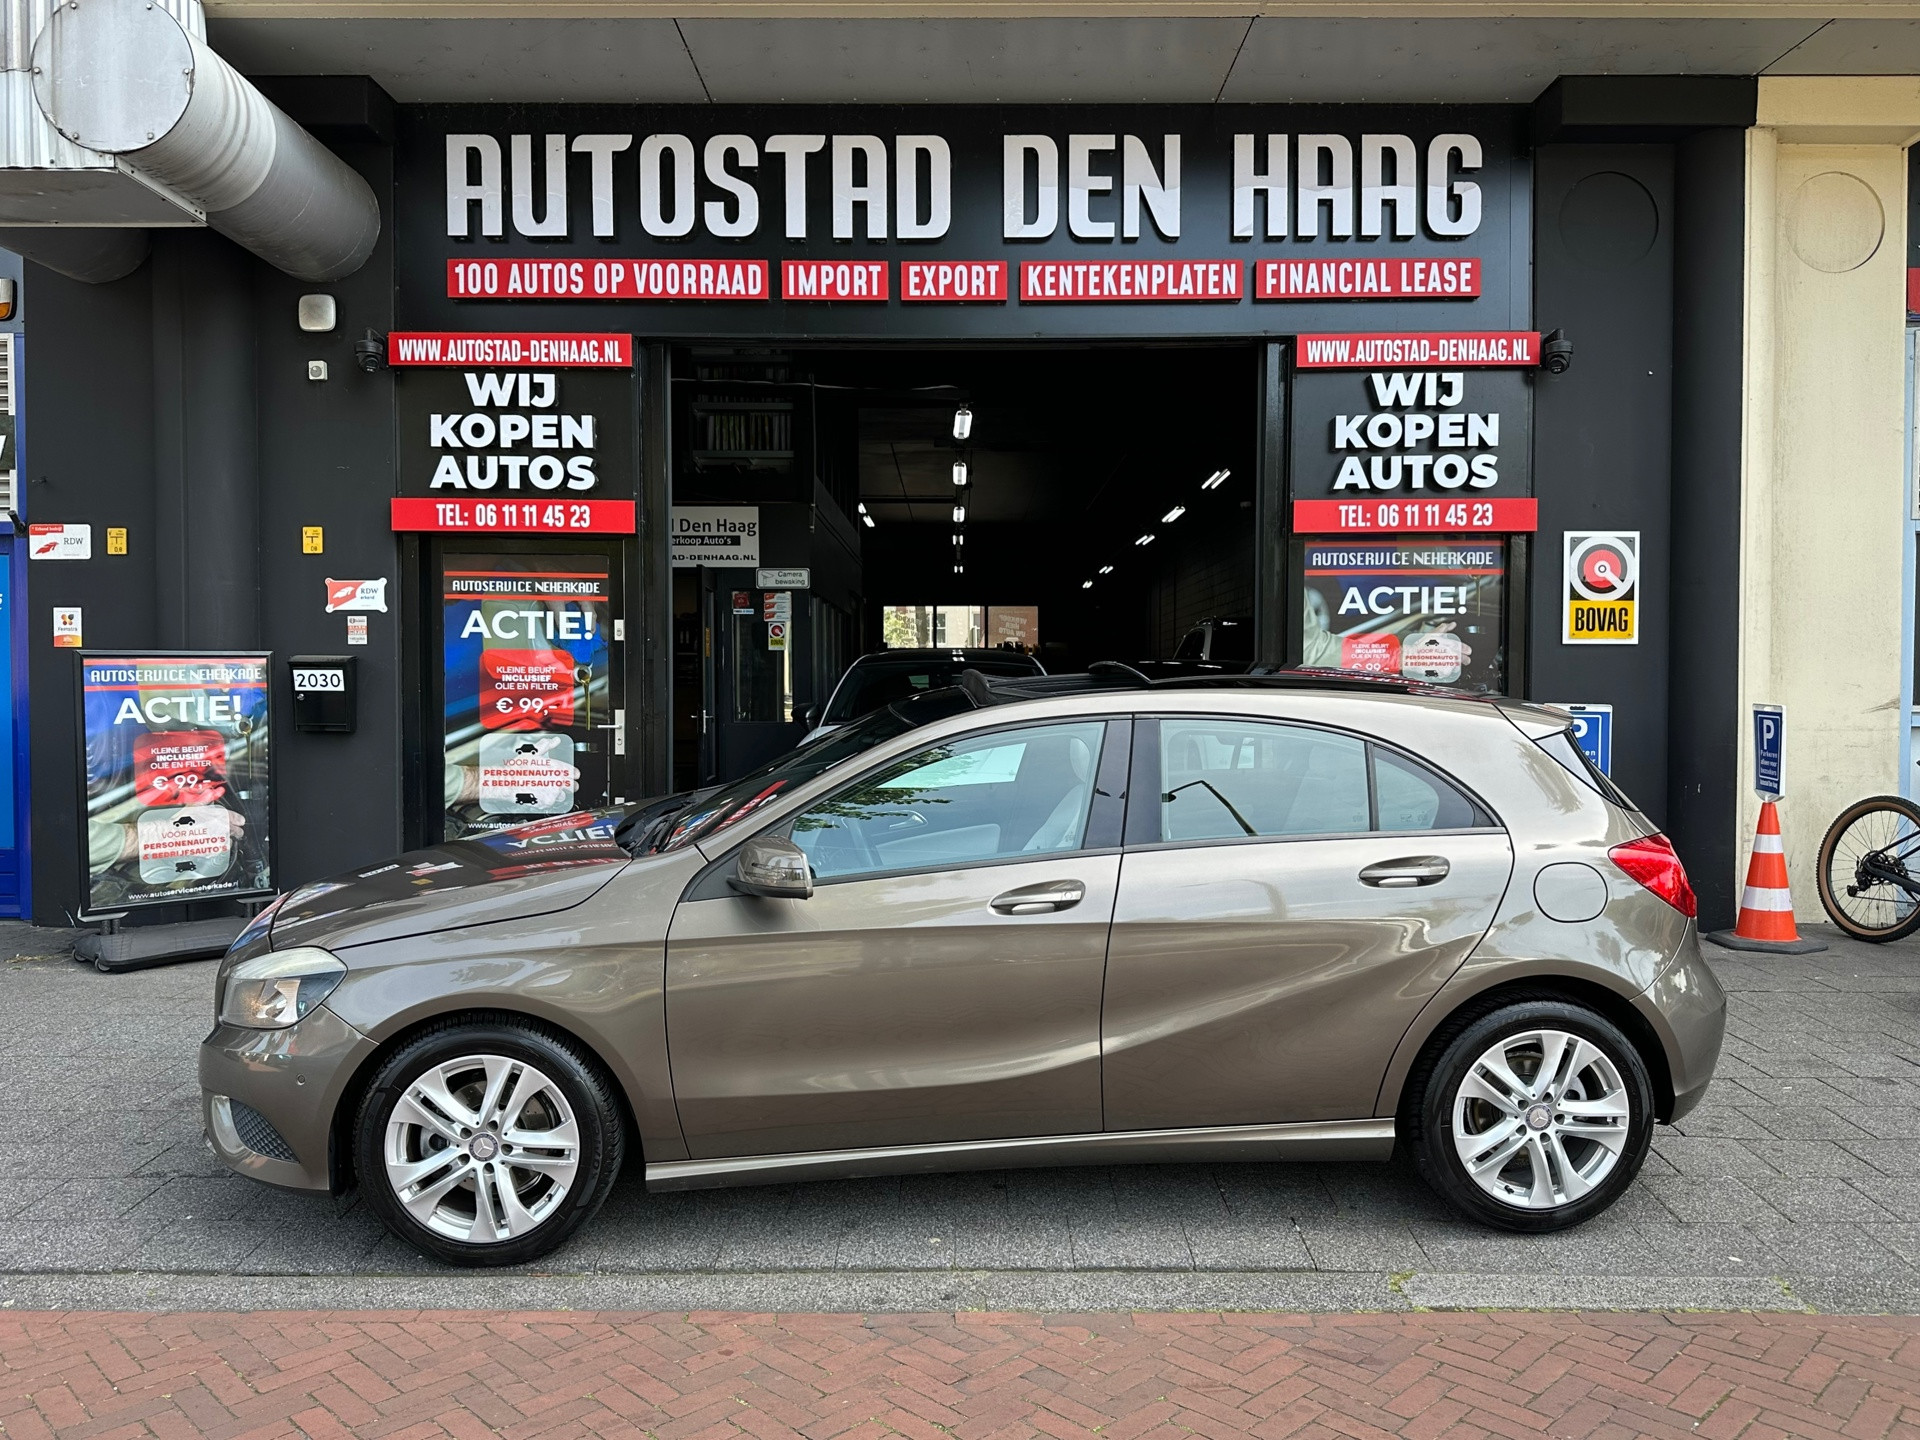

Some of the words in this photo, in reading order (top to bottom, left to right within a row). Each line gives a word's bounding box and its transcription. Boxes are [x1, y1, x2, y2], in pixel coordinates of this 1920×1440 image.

[446, 133, 952, 239] AUTOSTAD
[1003, 133, 1181, 238] DEN
[1232, 133, 1483, 237] HAAG
[455, 264, 498, 294] 100
[508, 263, 584, 295] AUTOS
[593, 264, 625, 295] OP
[633, 264, 763, 296] VOORRAAD
[788, 265, 882, 297] IMPORT
[908, 264, 999, 297] EXPORT
[1027, 263, 1237, 297] KENTEKENPLATEN
[1265, 262, 1390, 295] FINANCIAL
[1401, 261, 1472, 293] LEASE
[398, 339, 623, 363] WWW.AUTOSTAD-DENHAAG.NL
[1307, 338, 1531, 363] WWW.AUTOSTAD-DENHAAG.NL
[464, 372, 557, 408] WIJ
[1371, 372, 1464, 408] WIJ
[429, 414, 595, 449] KOPEN
[1335, 413, 1500, 448] KOPEN
[429, 455, 597, 491] AUTOS
[1333, 454, 1499, 490] AUTOS
[436, 504, 469, 527] TEL:
[475, 504, 498, 527] 06
[502, 504, 517, 527] 11
[523, 504, 538, 527] 11
[543, 504, 566, 527] 45
[570, 504, 591, 528] 23
[1338, 504, 1372, 527] TEL:
[1377, 504, 1400, 527] 06
[1405, 504, 1419, 527] 11
[1426, 504, 1440, 527] 11
[1445, 504, 1469, 526] 45
[1473, 503, 1494, 526] 23
[679, 519, 711, 533] Den
[716, 518, 757, 536] Haag
[63, 537, 84, 545] RDW
[703, 537, 732, 545] Auto's
[1312, 551, 1410, 566] AUTOSERVICE
[1413, 551, 1494, 566] NEHERKADE
[452, 580, 532, 593] AUTOSERVICE
[534, 581, 600, 594] NEHERKADE
[1337, 586, 1468, 615] ACTIE!
[460, 609, 593, 641] ACTIE!
[1574, 607, 1629, 633] BOVAG
[91, 668, 186, 683] AUTOSERVICE
[189, 667, 262, 682] NEHERKADE
[496, 666, 526, 675] KLEINE
[527, 666, 557, 674] BEURT
[501, 674, 552, 682] INCLUSIEF
[296, 673, 341, 688] 2030
[495, 682, 515, 691] OLIE
[516, 682, 530, 691] EN
[531, 682, 558, 691] FILTER
[113, 695, 243, 725] ACTIE!
[495, 697, 513, 714] €
[1763, 718, 1775, 750] P
[151, 746, 180, 755] KLEINE
[182, 745, 209, 753] BEURT
[156, 753, 206, 762] INCLUSIEF
[150, 761, 170, 770] OLIE
[172, 761, 184, 769] EN
[185, 759, 212, 769] FILTER
[503, 758, 529, 767] VOOR
[530, 758, 551, 767] ALLE
[483, 769, 570, 777] PERSONENAUTO'S
[152, 776, 169, 791] €
[481, 779, 490, 787] &
[491, 779, 571, 787] BEDRIJFSAUTO'S
[161, 829, 187, 839] VOOR
[188, 828, 208, 837] ALLE
[467, 822, 516, 830] www.autose
[143, 835, 226, 850] PERSONENAUTO'S
[142, 852, 150, 860] &
[151, 845, 228, 860] BEDRIJFSAUTO'S
[128, 880, 239, 900] www.autoserviceneherkade.nl
